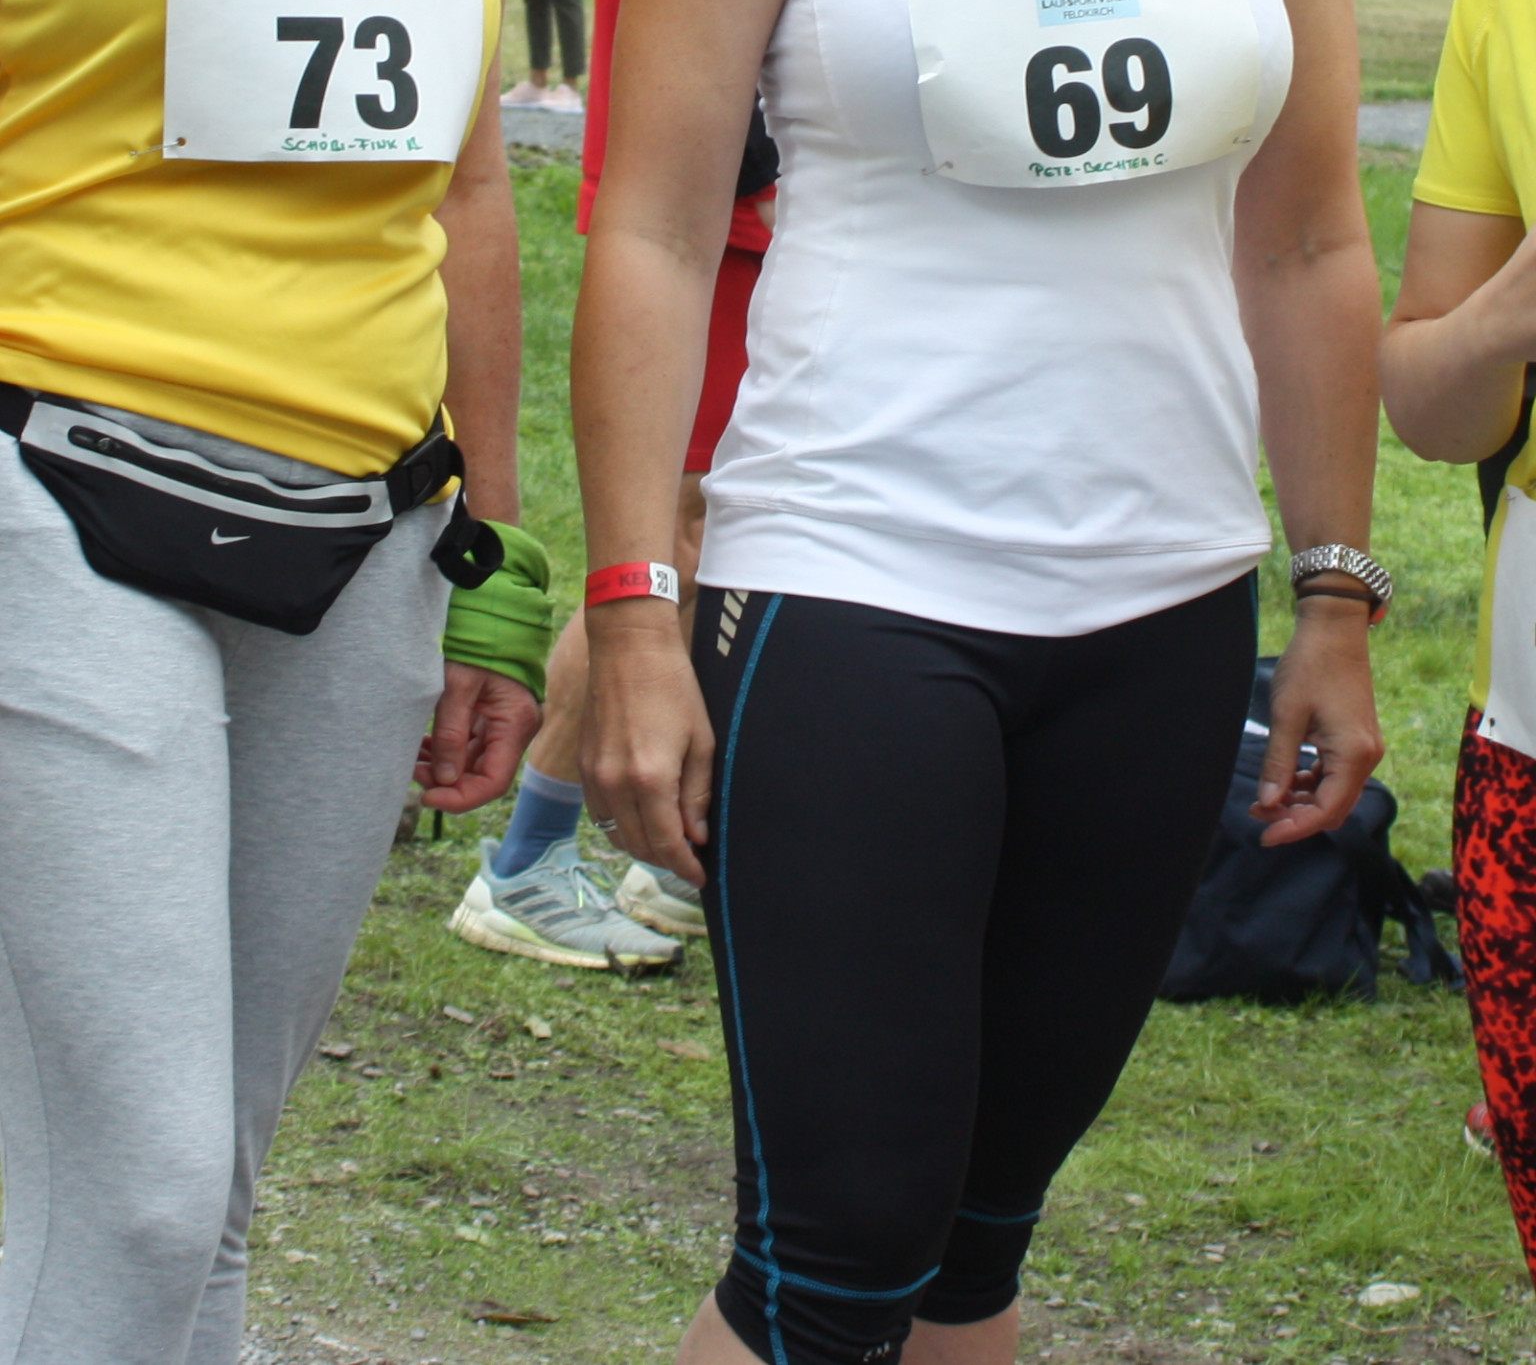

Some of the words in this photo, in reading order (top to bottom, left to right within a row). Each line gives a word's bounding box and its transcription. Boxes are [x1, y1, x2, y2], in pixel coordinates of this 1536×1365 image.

[1063, 6, 1114, 19] FELDKIRCH
[276, 15, 419, 131] 73
[1024, 37, 1173, 159] 69
